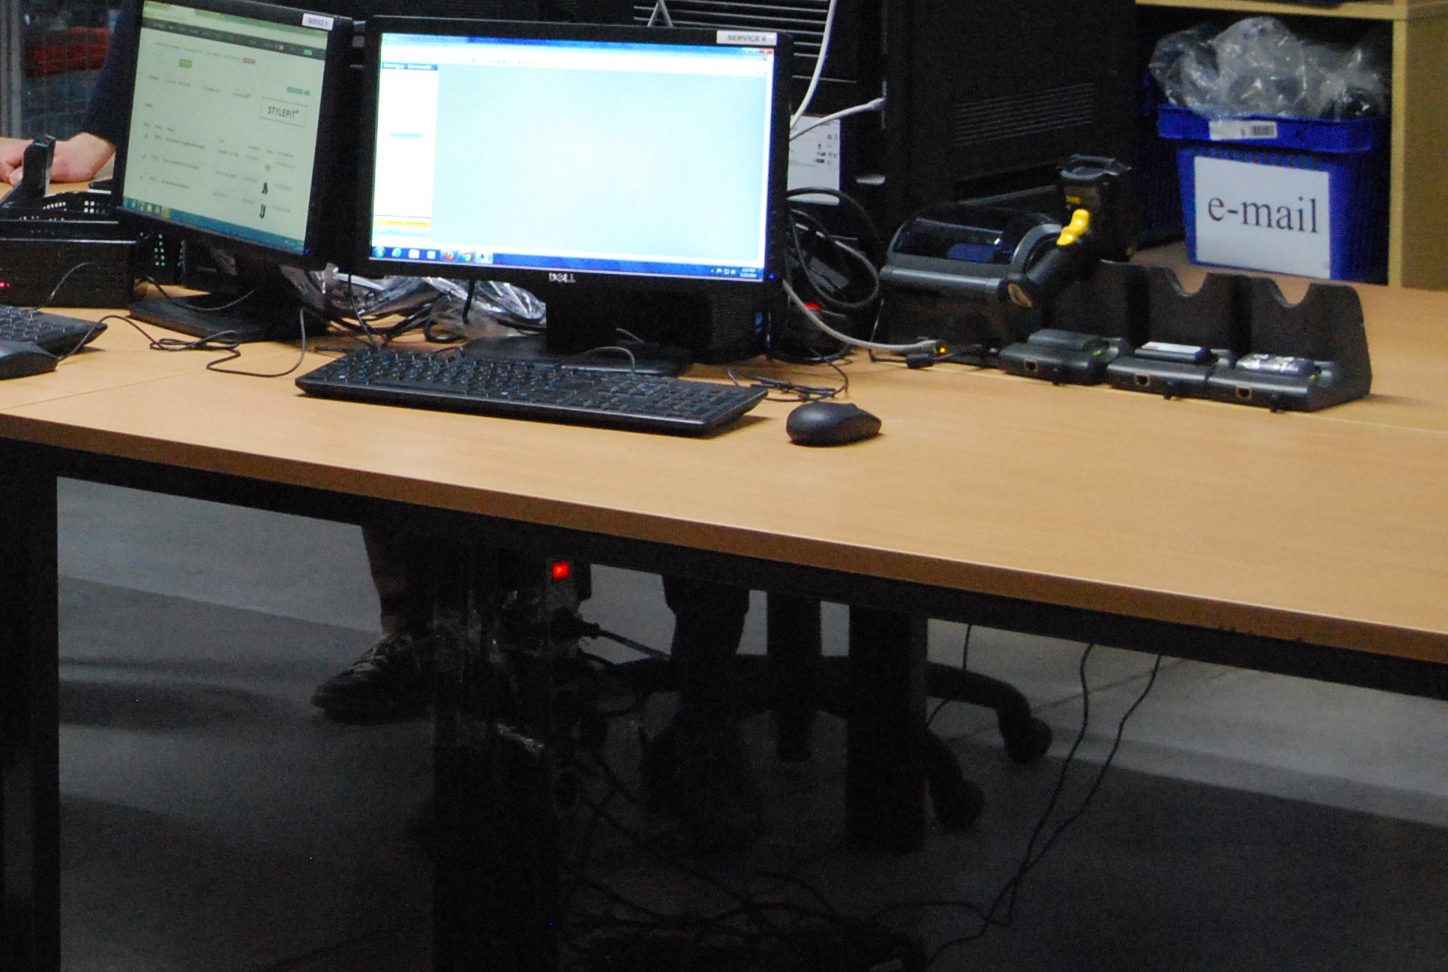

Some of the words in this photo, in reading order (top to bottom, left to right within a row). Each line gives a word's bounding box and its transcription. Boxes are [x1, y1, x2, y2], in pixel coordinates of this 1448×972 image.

[728, 34, 759, 43] SERVICE
[1207, 195, 1319, 234] e-mail
[548, 273, 576, 283] DELL
